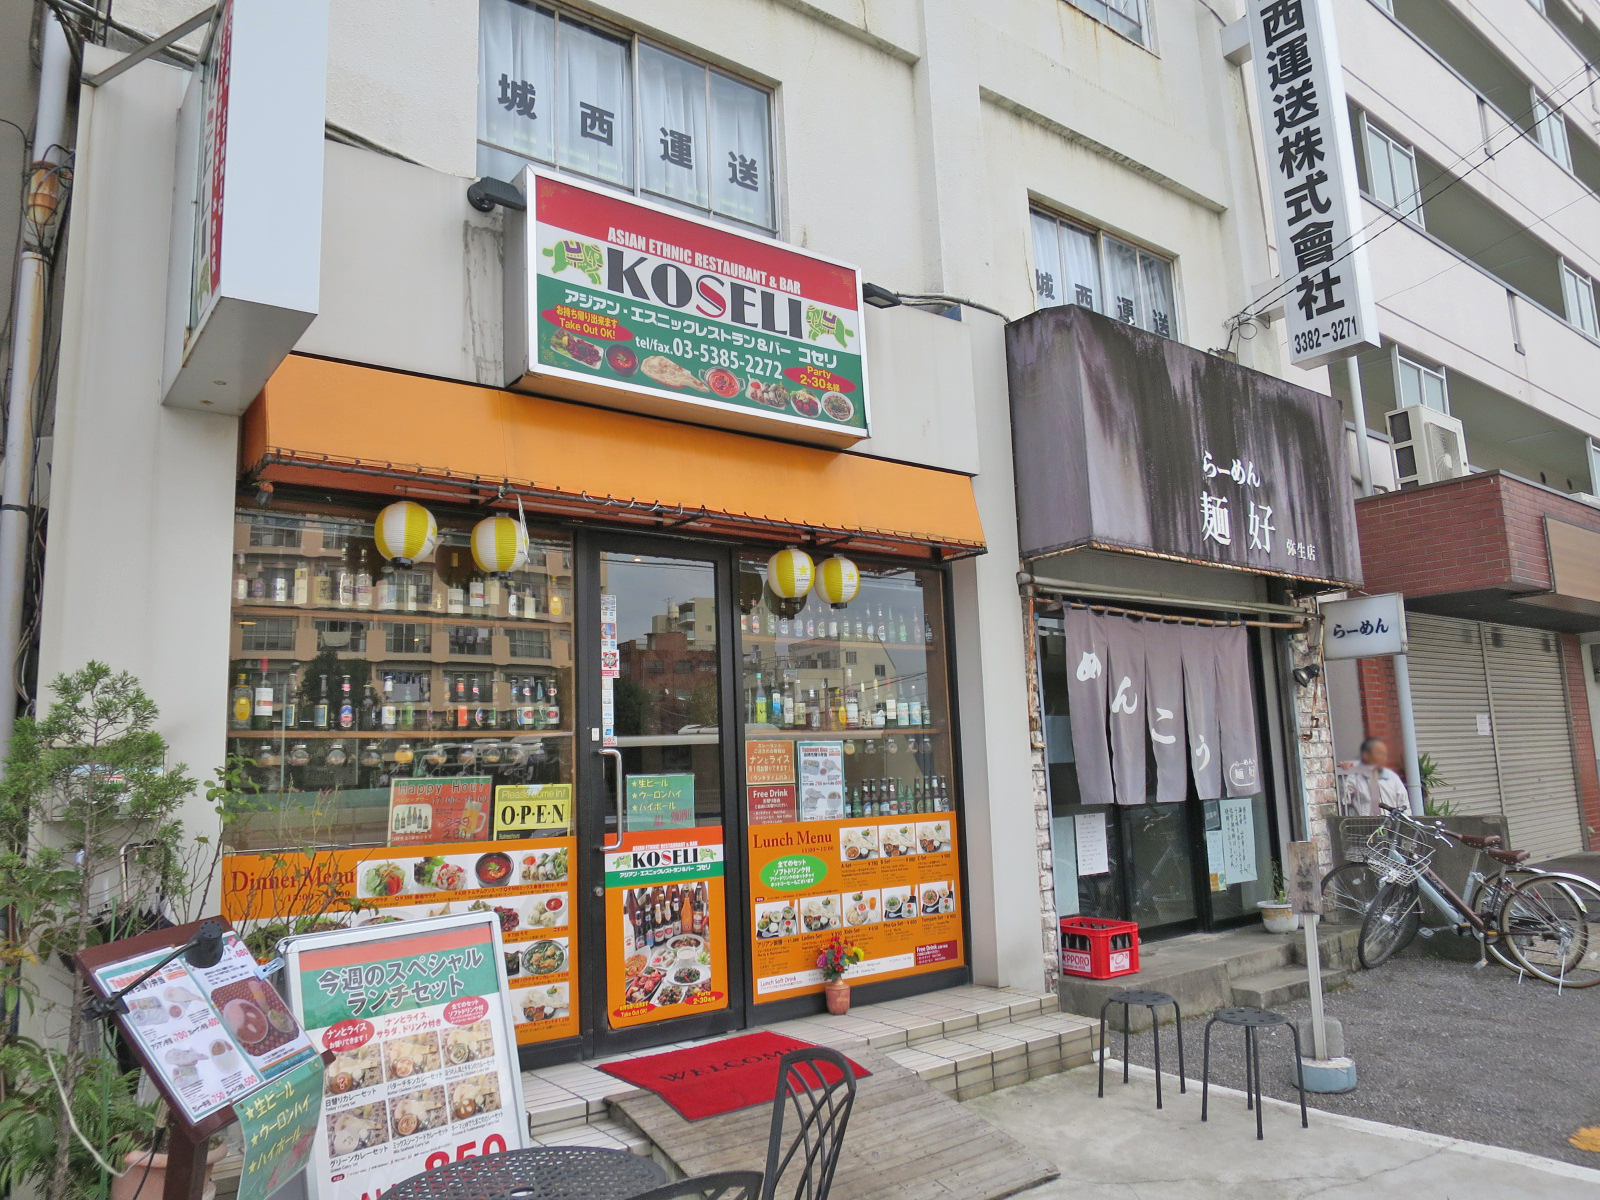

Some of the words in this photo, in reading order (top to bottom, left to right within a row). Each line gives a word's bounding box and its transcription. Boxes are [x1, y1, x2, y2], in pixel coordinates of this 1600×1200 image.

[497, 73, 758, 192] 城西運送
[608, 227, 646, 251] ASIAN
[649, 239, 692, 264] ETHNIC
[695, 252, 767, 285] RESTAURANT
[769, 276, 777, 288] &
[779, 277, 801, 295] BAR
[607, 247, 803, 339] KOSELI
[556, 304, 618, 329] お持ち帰り出来ます
[559, 317, 580, 331] Take
[583, 323, 598, 336] Out
[600, 327, 616, 339] OK!
[1294, 316, 1357, 354] 3382-3271
[798, 347, 837, 369] コセリ
[807, 365, 831, 379] Party
[1202, 450, 1260, 488] らーめん
[1286, 538, 1316, 561] 弥生店
[1333, 617, 1389, 639] らーめん
[1076, 651, 1210, 771] めんこう
[750, 755, 790, 764] ナンとライス
[398, 782, 443, 796] Happy
[452, 781, 485, 793] Hour
[638, 779, 668, 788] 生ビール
[753, 790, 768, 798] Free
[769, 788, 788, 798] Drink
[501, 789, 529, 799] Please
[639, 790, 681, 799] ウーロンハイ
[640, 801, 676, 811] ハイボール
[753, 832, 793, 849] Lunch
[797, 830, 832, 845] Menu
[632, 848, 698, 868] KOSELI
[696, 863, 711, 871] コセリ
[778, 859, 806, 868] 全てのセット
[774, 866, 811, 875] ソフトドリンク付
[317, 947, 484, 996] 今週のスペシャル
[760, 979, 774, 987] Lunch
[346, 974, 465, 1016] ランチセット
[451, 999, 479, 1010] 全てのセット
[448, 1004, 484, 1017] ソフトドリンク付
[326, 1022, 367, 1040] ナンとライス
[386, 1072, 442, 1091] バターチキンカレーセット
[254, 1081, 295, 1119] 生ビール
[325, 1088, 377, 1107] 日替りカレーセット
[260, 1093, 310, 1140] ウーロンハイ
[257, 1124, 300, 1170] ハイボール
[393, 1128, 448, 1149] ミックスシーフードカレーセット
[330, 1145, 388, 1168] グリーンカレーセット
